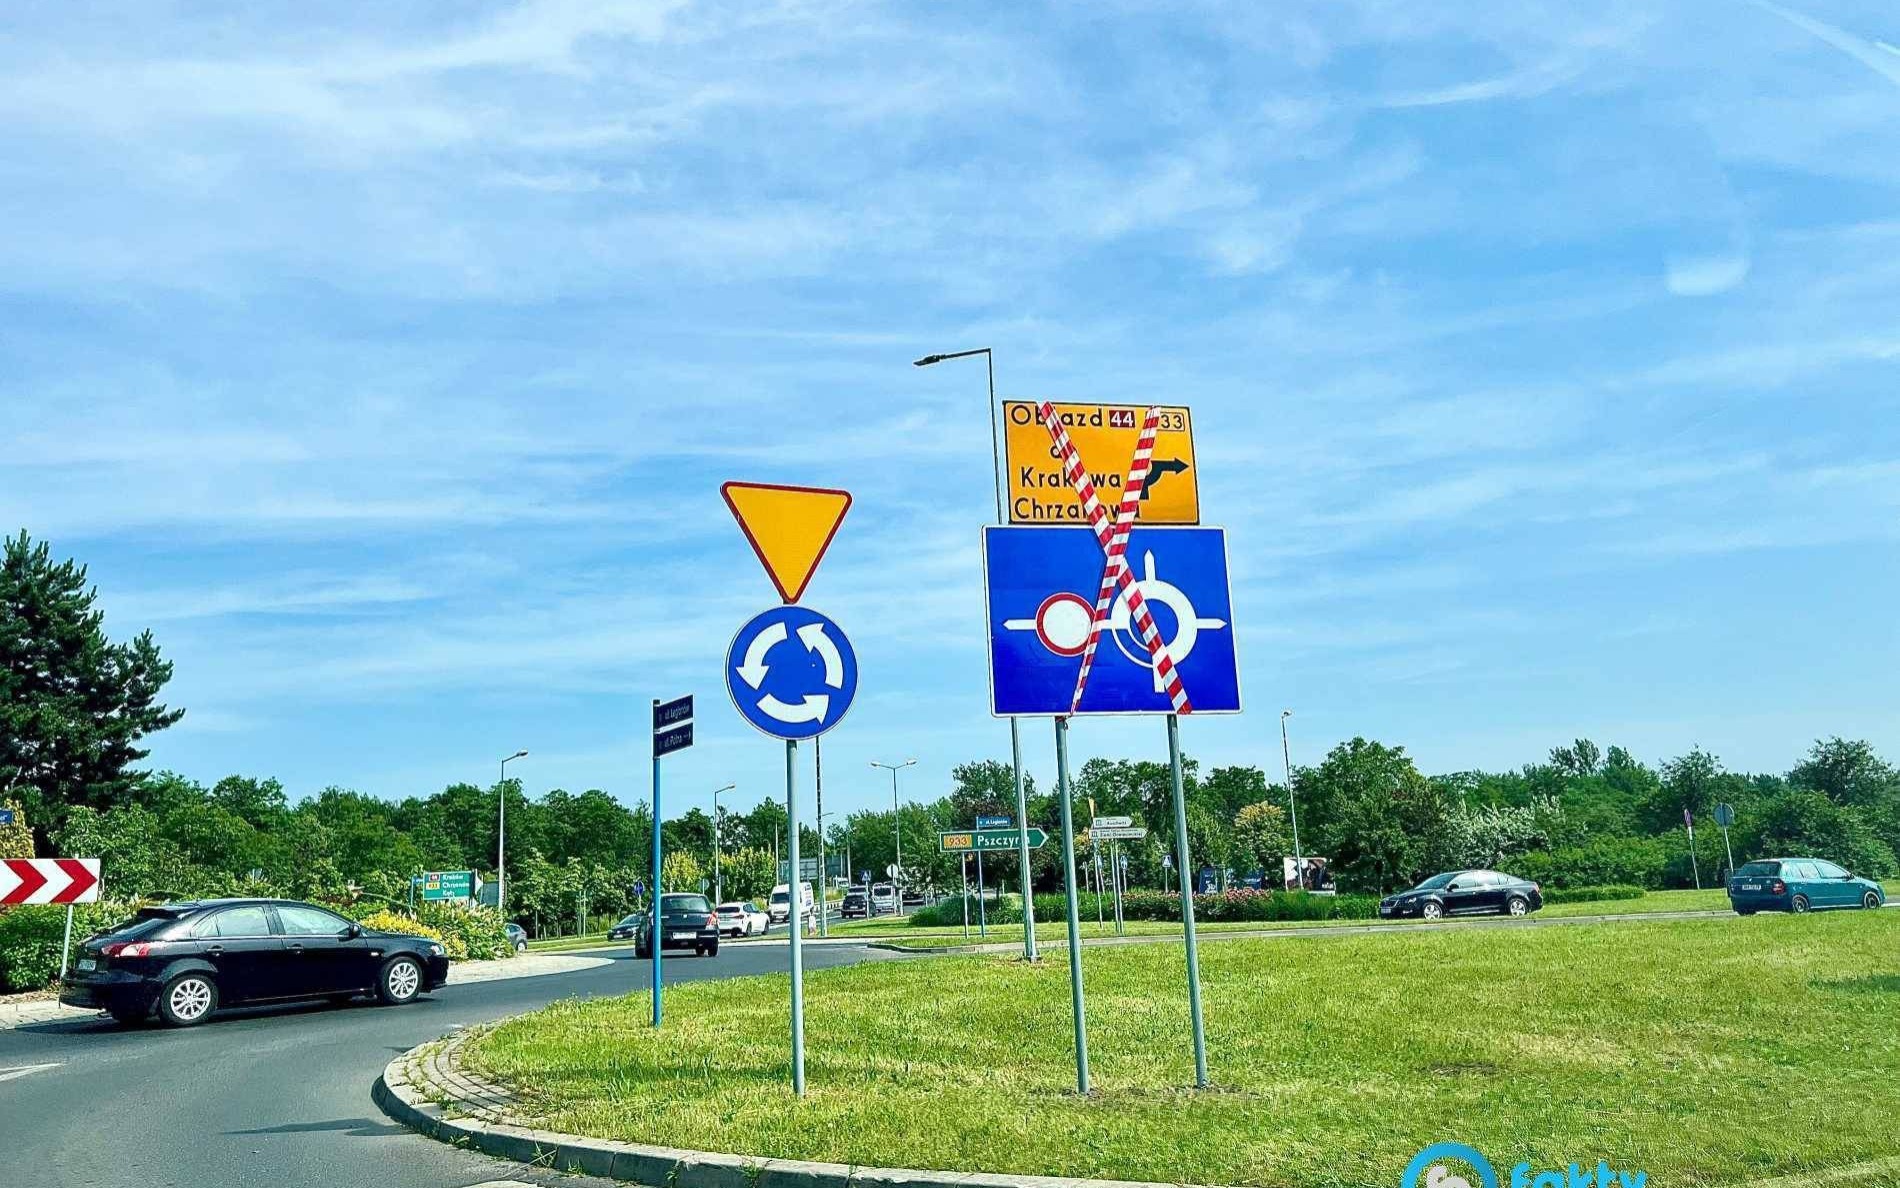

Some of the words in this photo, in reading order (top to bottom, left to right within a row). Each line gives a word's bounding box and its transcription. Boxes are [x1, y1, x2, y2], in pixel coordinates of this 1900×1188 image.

[1011, 404, 1103, 427] Obazd
[1111, 411, 1134, 427] 44
[1159, 414, 1183, 429] 33
[1020, 466, 1121, 488] Krakwa
[1014, 497, 1140, 519] Chrzaw
[949, 836, 968, 847] 933
[977, 834, 1030, 849] Pszczyn
